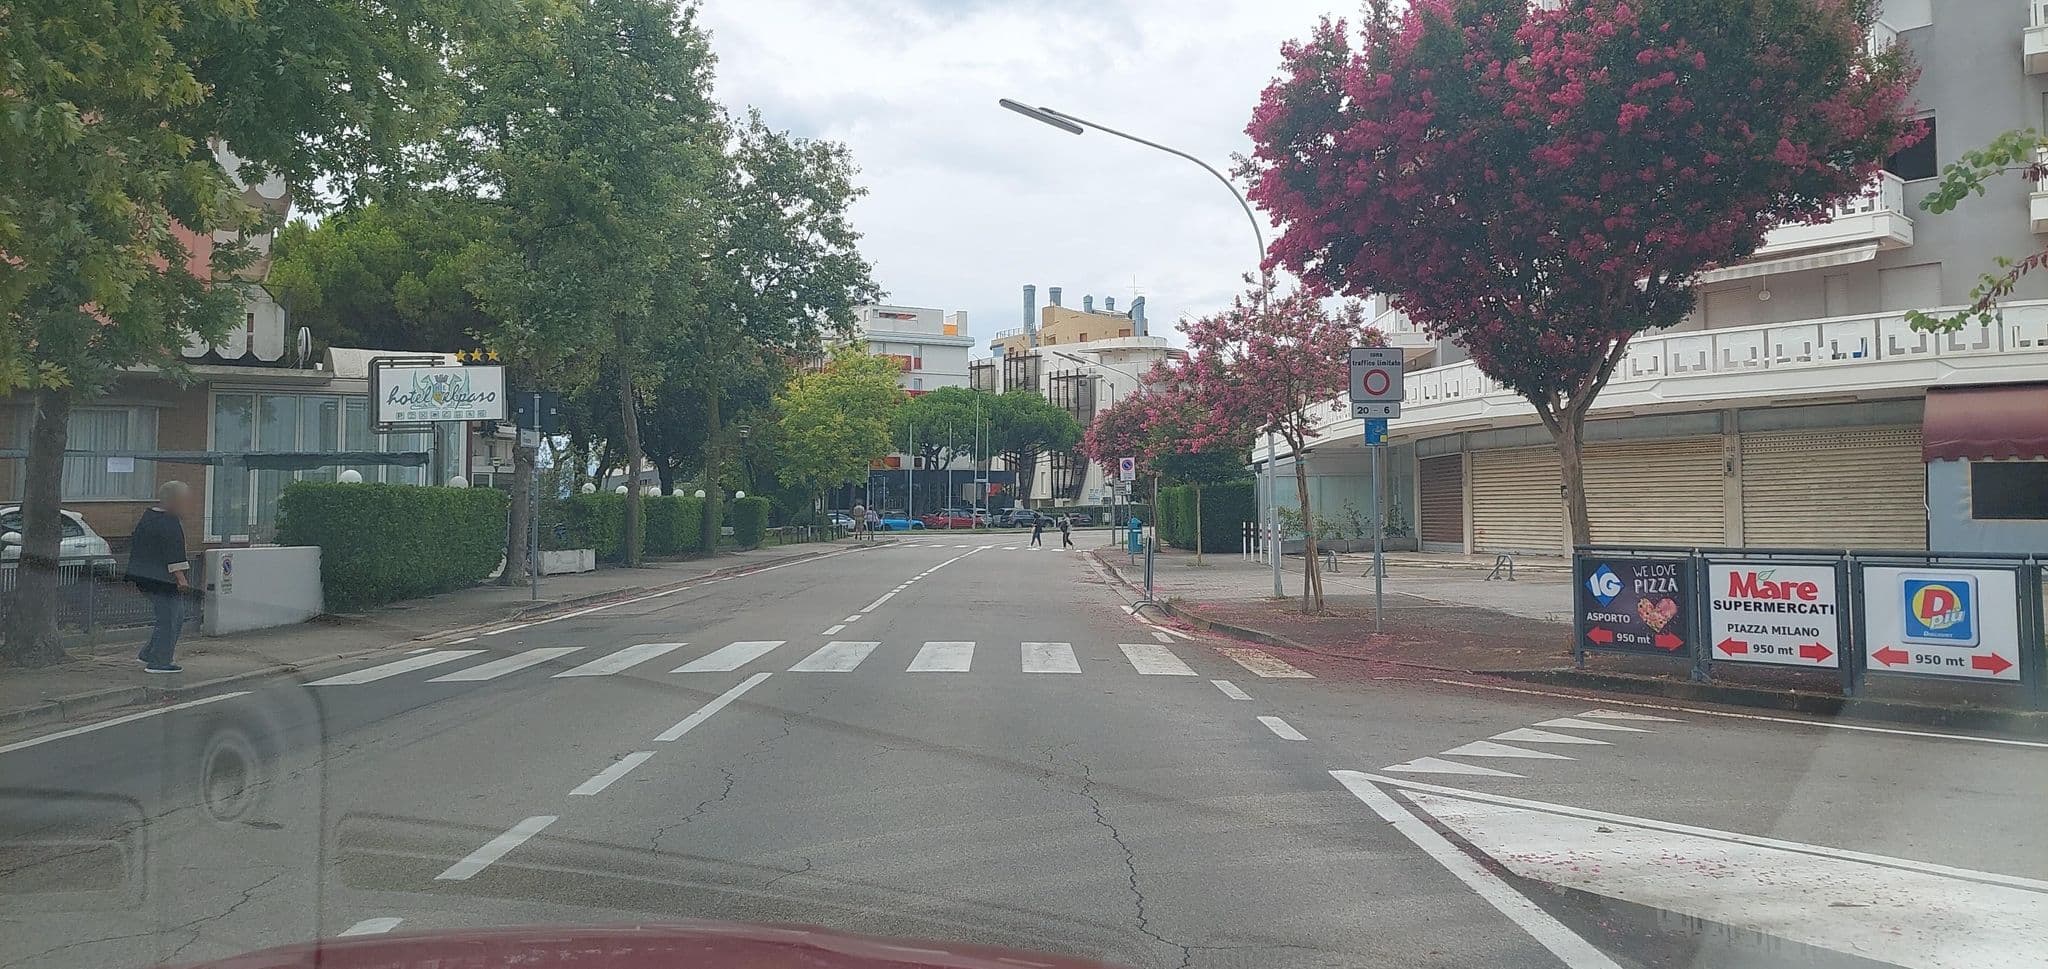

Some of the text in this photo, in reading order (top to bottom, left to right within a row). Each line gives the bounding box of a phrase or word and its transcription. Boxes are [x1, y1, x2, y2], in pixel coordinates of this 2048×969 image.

[387, 385, 432, 406] hotel
[1357, 406, 1369, 415] 20
[1383, 406, 1390, 414] 6
[1633, 564, 1677, 578] WE LOVE
[1589, 572, 1621, 597] IG
[1634, 578, 1679, 594] PIZZA
[1728, 571, 1819, 601] Mare
[1713, 600, 1835, 615] SUPERMERCATI
[1586, 612, 1631, 624] ASPORTO
[1727, 623, 1820, 638] PIAZZA MILANO
[1616, 633, 1651, 644] 950 mt
[1753, 643, 1794, 655] 950 mt
[1915, 653, 1966, 668] 950 mt
